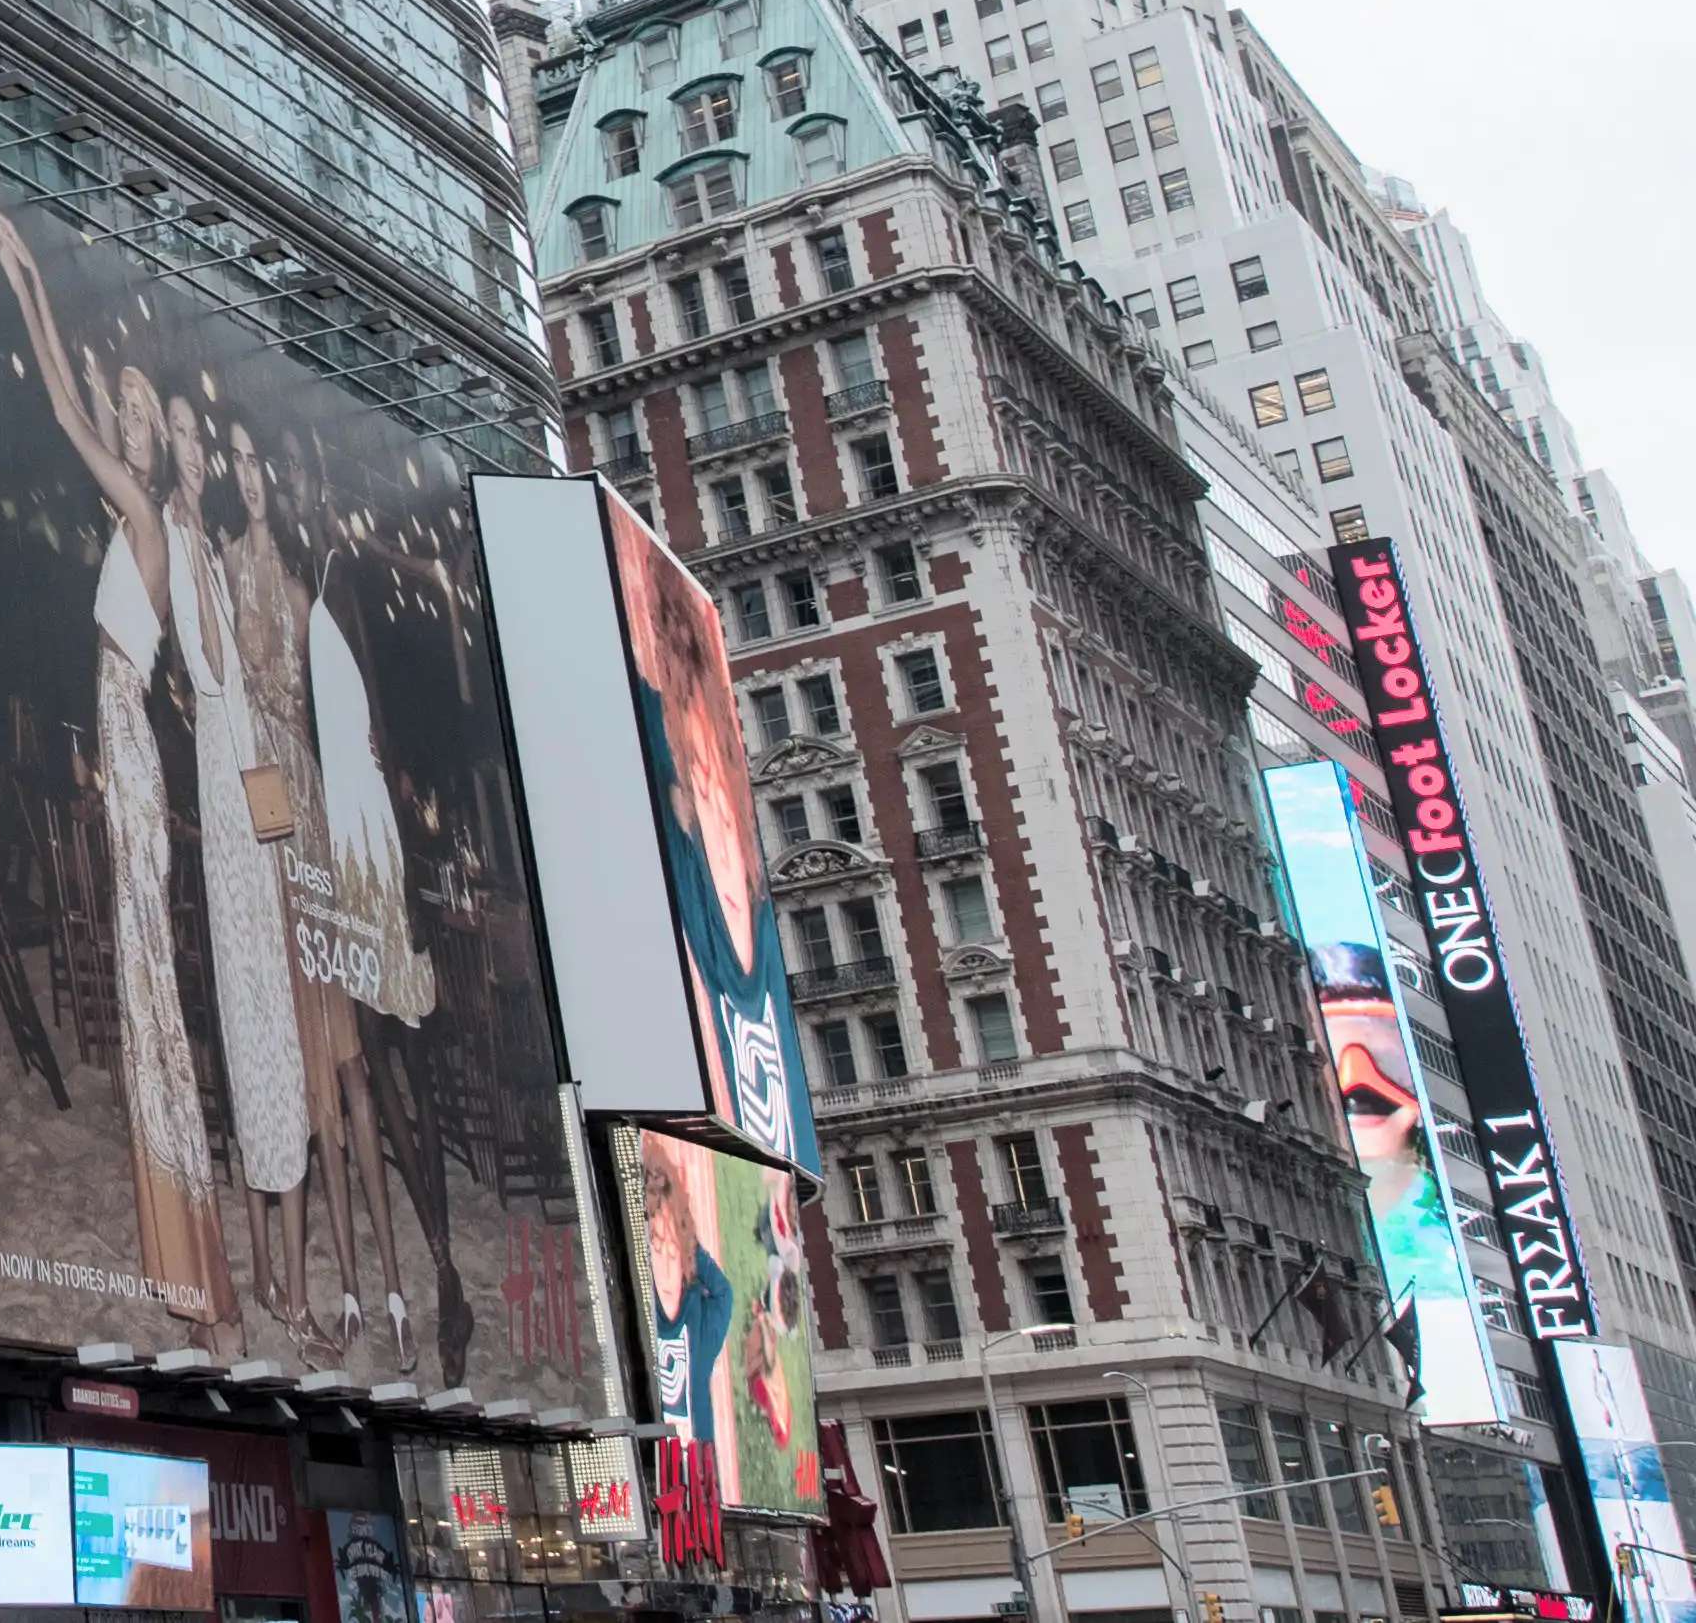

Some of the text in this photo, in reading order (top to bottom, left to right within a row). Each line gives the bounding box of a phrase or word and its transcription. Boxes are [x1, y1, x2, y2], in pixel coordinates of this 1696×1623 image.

[1391, 738, 1463, 854] Foot
[283, 845, 334, 897] Dress
[296, 916, 381, 1000] $34.99
[1483, 1109, 1536, 1134] 1
[0, 1252, 208, 1311] NOW IN STORES AND AT HM.COM
[501, 1216, 583, 1379] H&M
